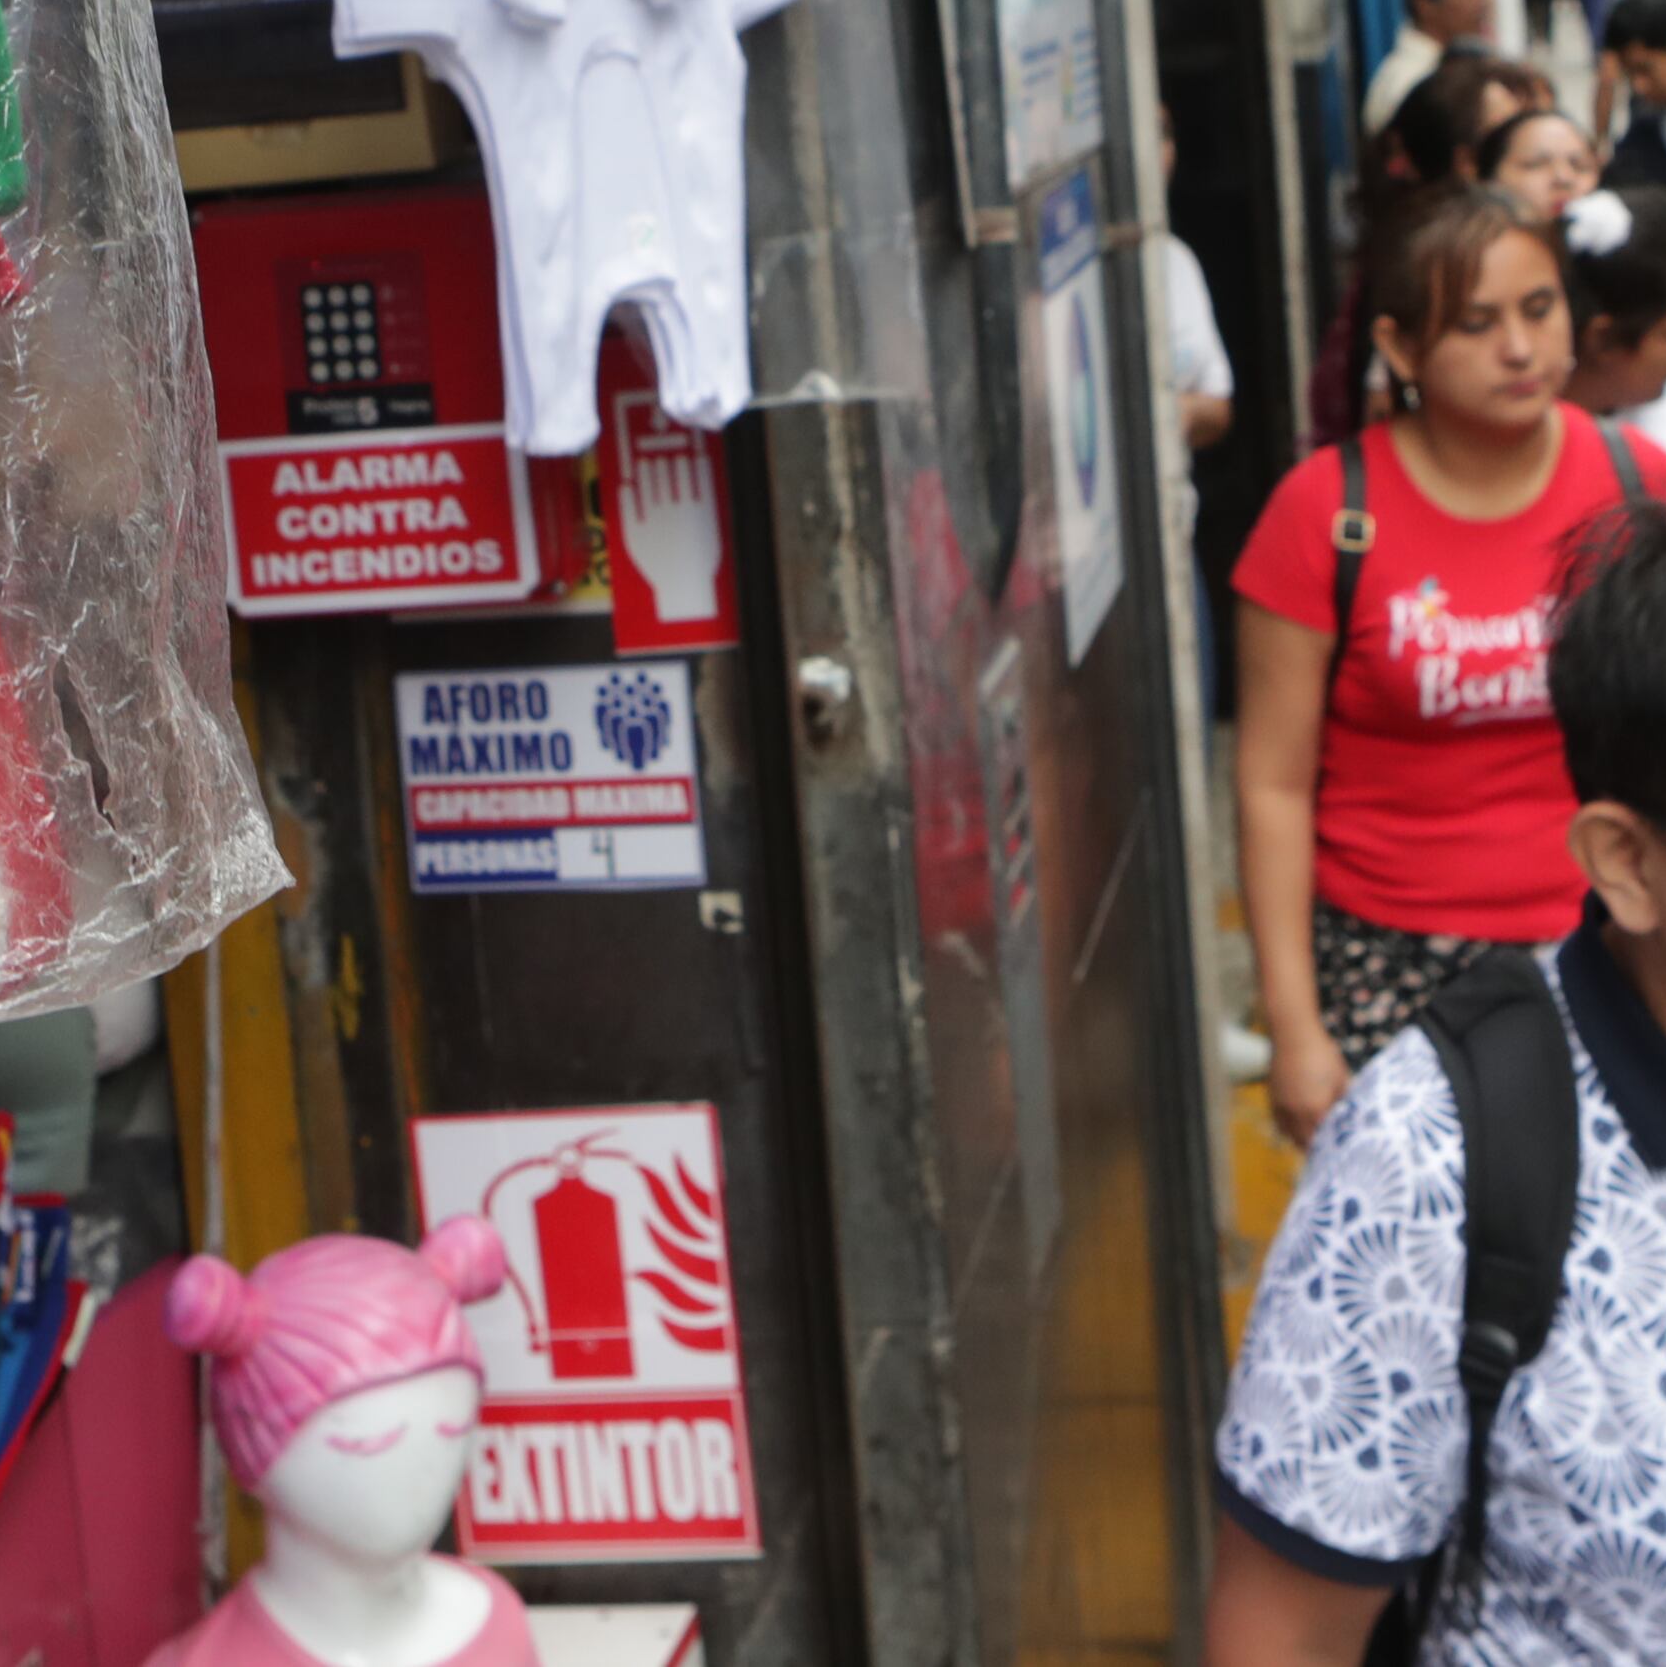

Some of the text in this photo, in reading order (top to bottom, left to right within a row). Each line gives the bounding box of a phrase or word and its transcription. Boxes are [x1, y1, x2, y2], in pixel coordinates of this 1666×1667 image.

[272, 451, 464, 495] ALARMA
[276, 496, 469, 540] CONTRA
[251, 539, 504, 588] INCENDIOS
[423, 680, 551, 725] AFORO
[416, 786, 571, 824] CAPACIDAD
[415, 829, 617, 881] PERSONAS 4
[472, 1419, 742, 1524] EXTINTOR
